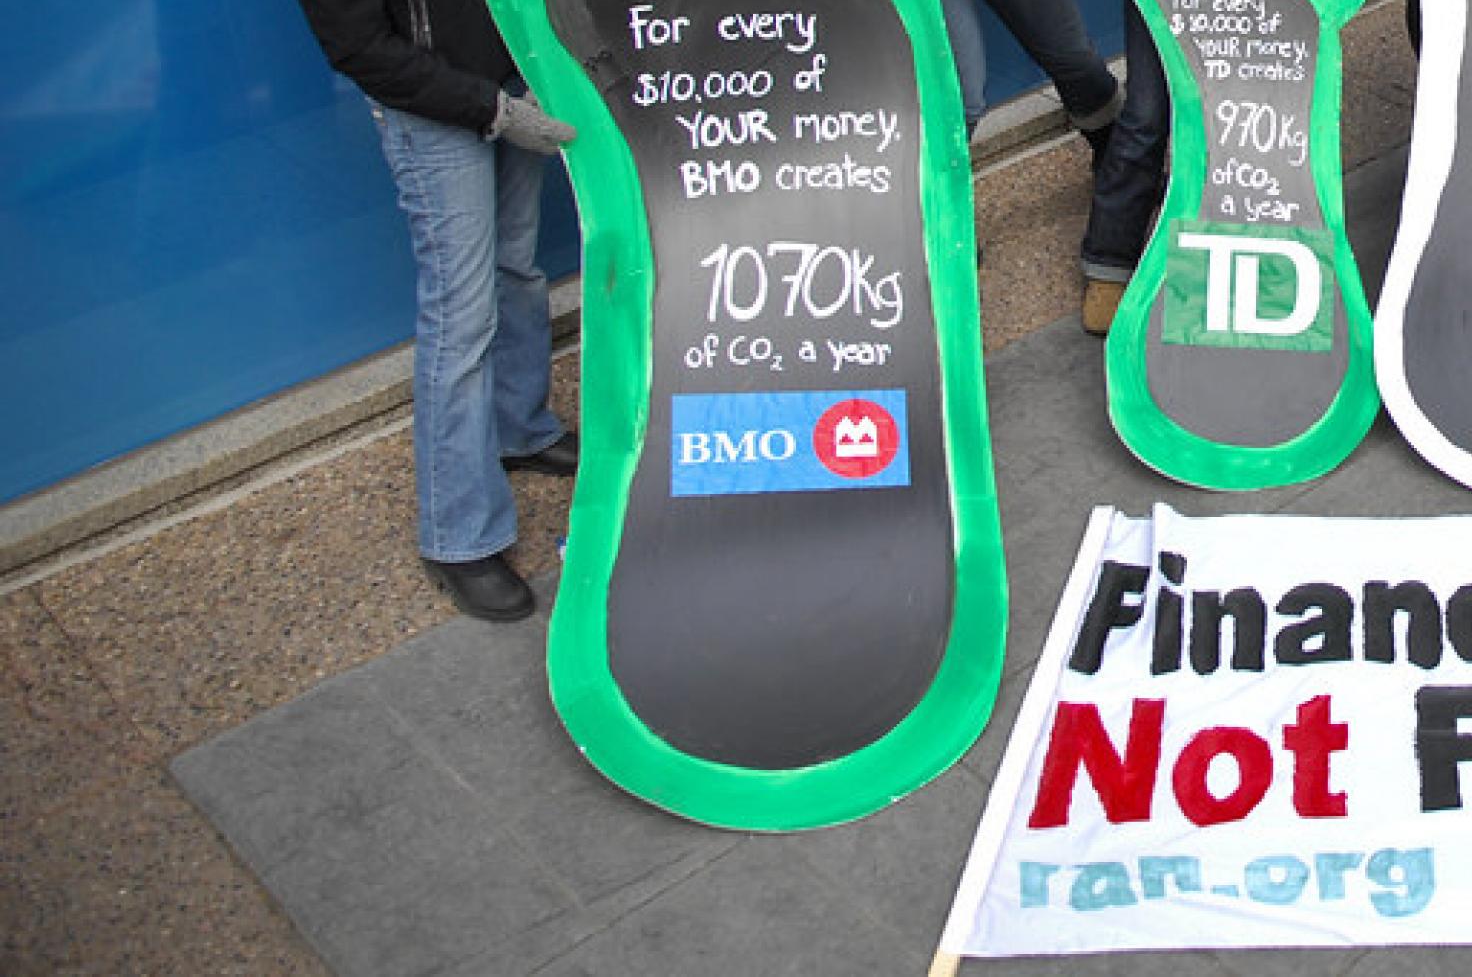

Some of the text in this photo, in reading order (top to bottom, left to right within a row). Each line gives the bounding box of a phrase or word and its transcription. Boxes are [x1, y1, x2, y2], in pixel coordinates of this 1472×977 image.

[629, 4, 817, 53] For every
[1258, 10, 1282, 34] of
[632, 53, 827, 106] $10,000 of
[1203, 59, 1306, 81] TD creates
[675, 108, 777, 149] YOUR
[680, 153, 892, 198] BMO creates
[1212, 157, 1239, 185] of
[1220, 194, 1300, 222] a year
[1177, 232, 1321, 335] TD
[684, 333, 719, 367] of
[798, 341, 816, 362] a
[826, 337, 892, 371] year
[678, 428, 797, 463] BMO
[1027, 693, 1349, 830] Not
[1018, 846, 1436, 918] ran.org
